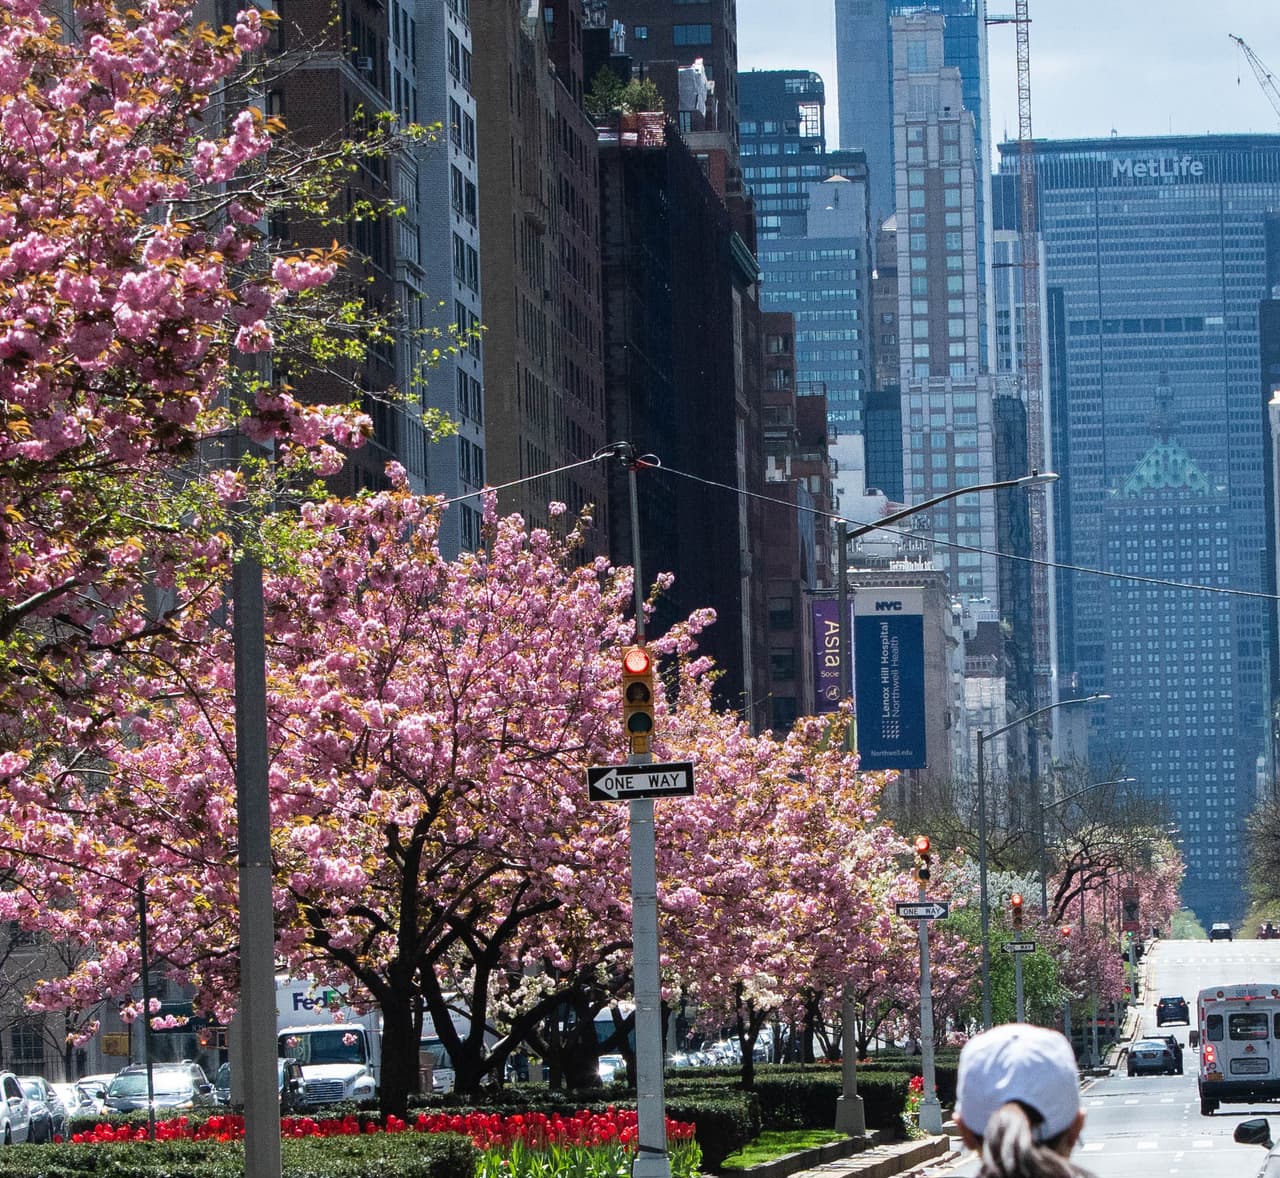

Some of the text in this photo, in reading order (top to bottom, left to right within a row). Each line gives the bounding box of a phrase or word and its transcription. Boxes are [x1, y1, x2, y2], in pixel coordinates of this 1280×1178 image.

[1111, 156, 1204, 178] MetLife
[875, 601, 902, 611] NYC
[880, 622, 891, 718] Lenox Hill Hospital
[890, 636, 900, 718] Northwell Health
[604, 773, 680, 791] ONE WAY
